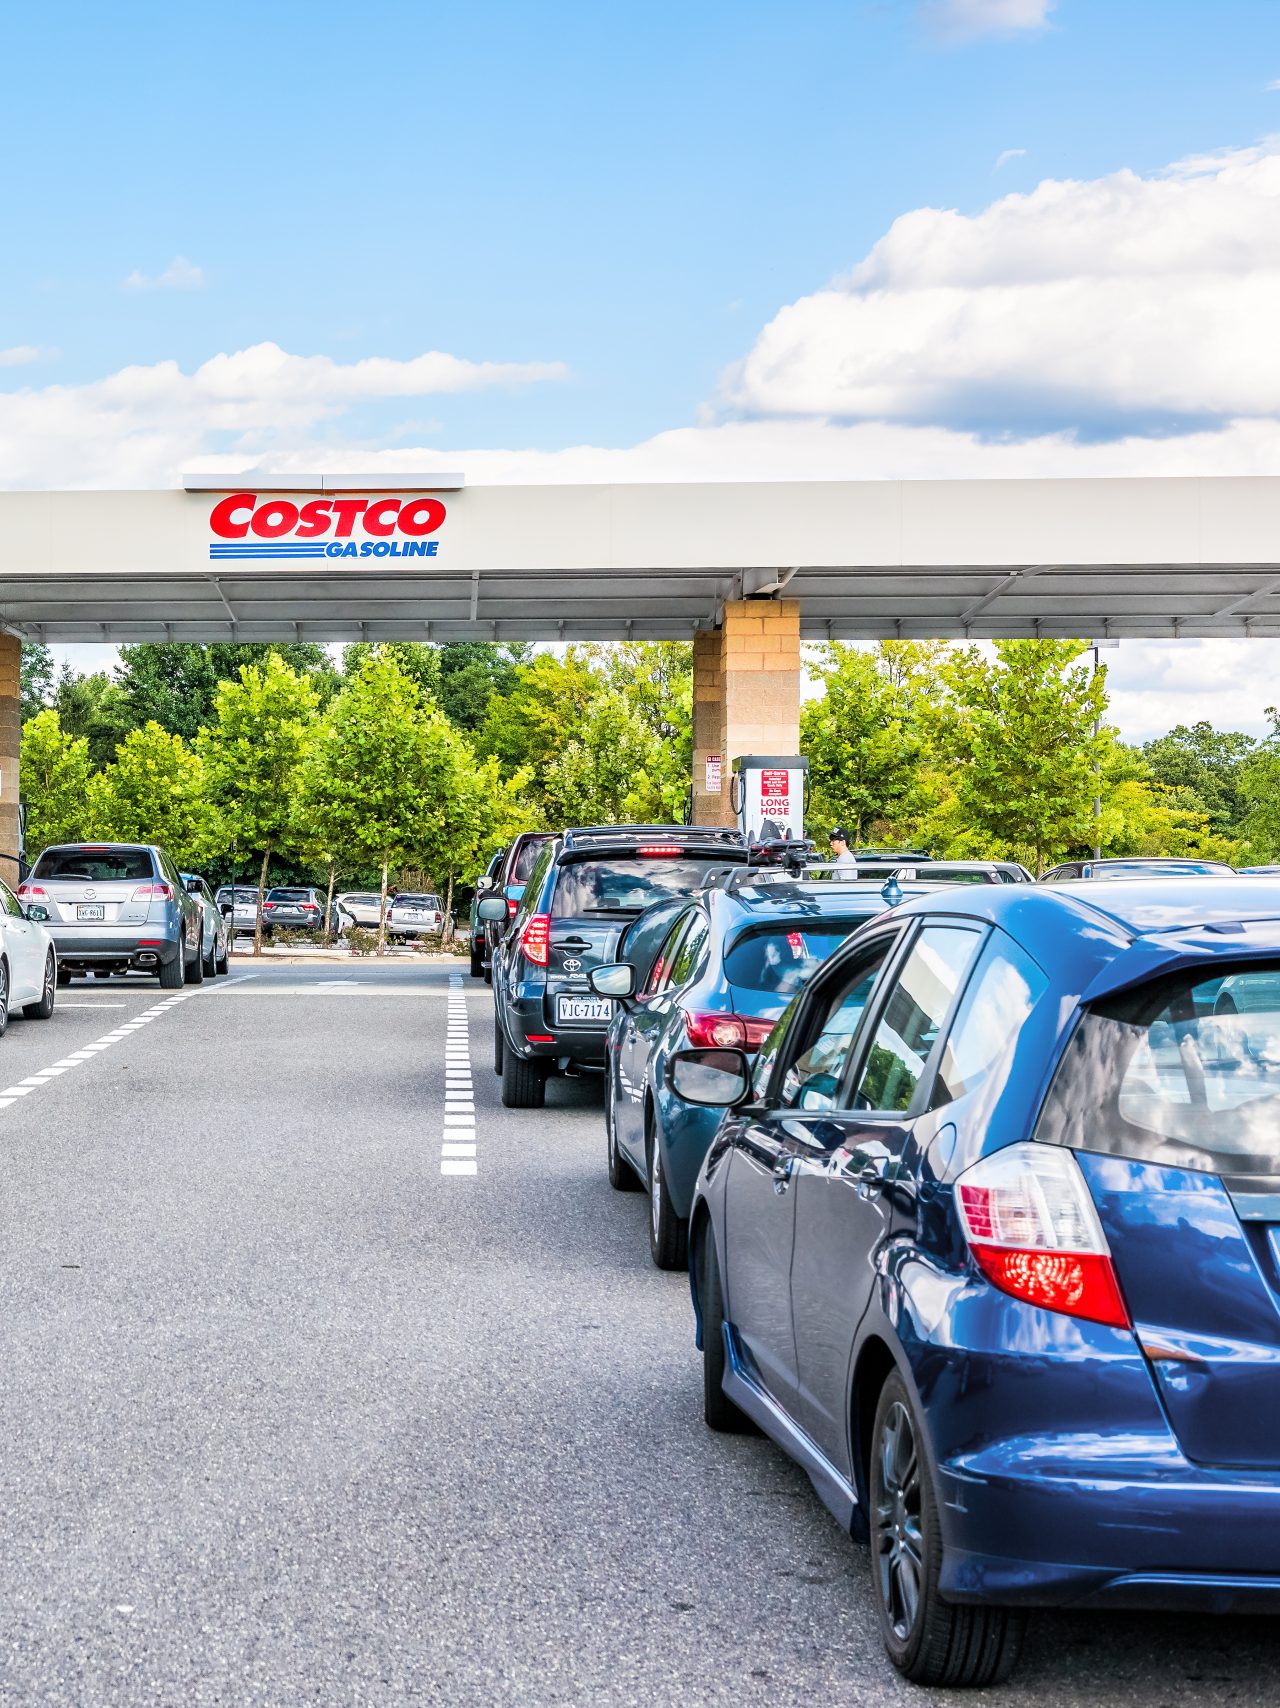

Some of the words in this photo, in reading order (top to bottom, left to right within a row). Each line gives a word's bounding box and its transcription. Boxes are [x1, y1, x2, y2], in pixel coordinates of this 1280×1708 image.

[210, 493, 446, 538] COSTCO
[325, 541, 439, 557] GASOLINE
[562, 1005, 610, 1017] VJC-7174
